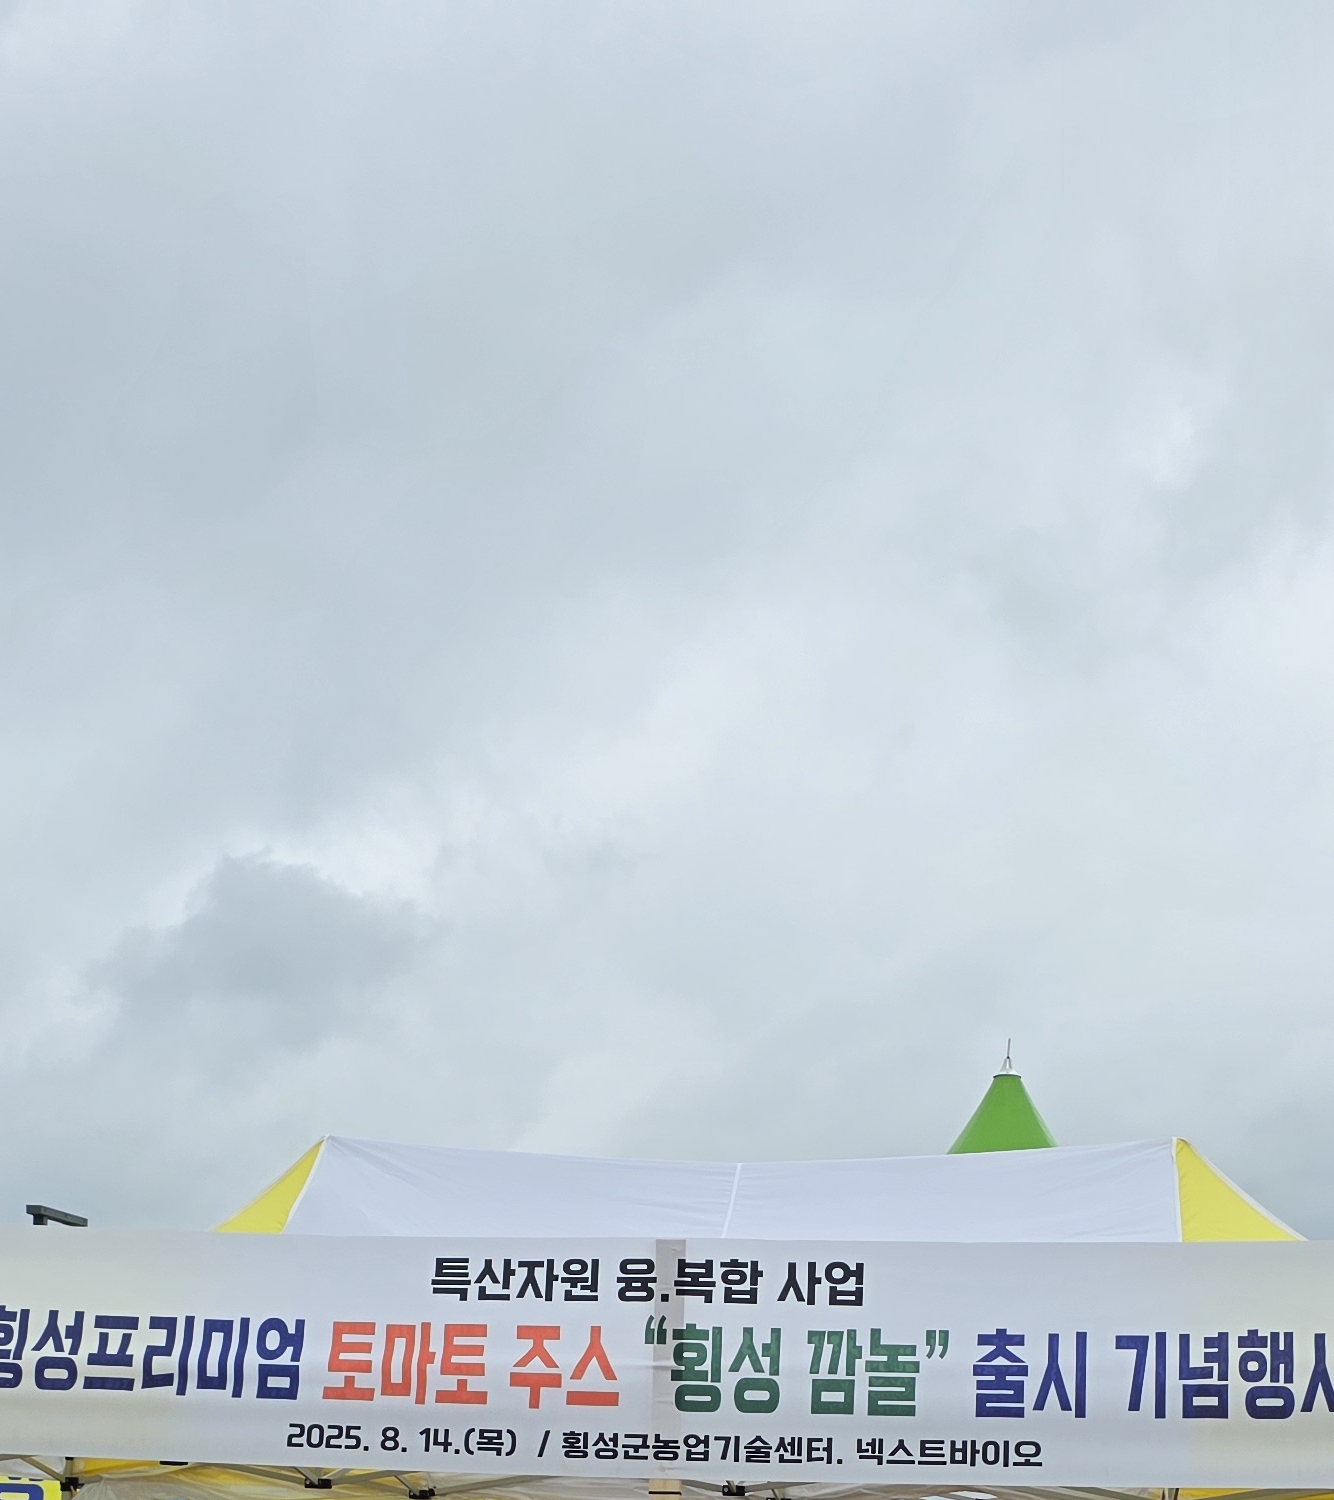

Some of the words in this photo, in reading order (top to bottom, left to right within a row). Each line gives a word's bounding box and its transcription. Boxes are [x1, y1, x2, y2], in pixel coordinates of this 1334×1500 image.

[431, 1257, 601, 1304] 특산자원
[777, 1262, 867, 1309] 사업
[323, 1321, 489, 1405] 토마토
[509, 1325, 621, 1411] 주스
[972, 1329, 1090, 1420] 출시
[286, 1423, 370, 1452] 2025.
[379, 1426, 408, 1453] 8.
[857, 1437, 1045, 1469] 넥스트바이오
